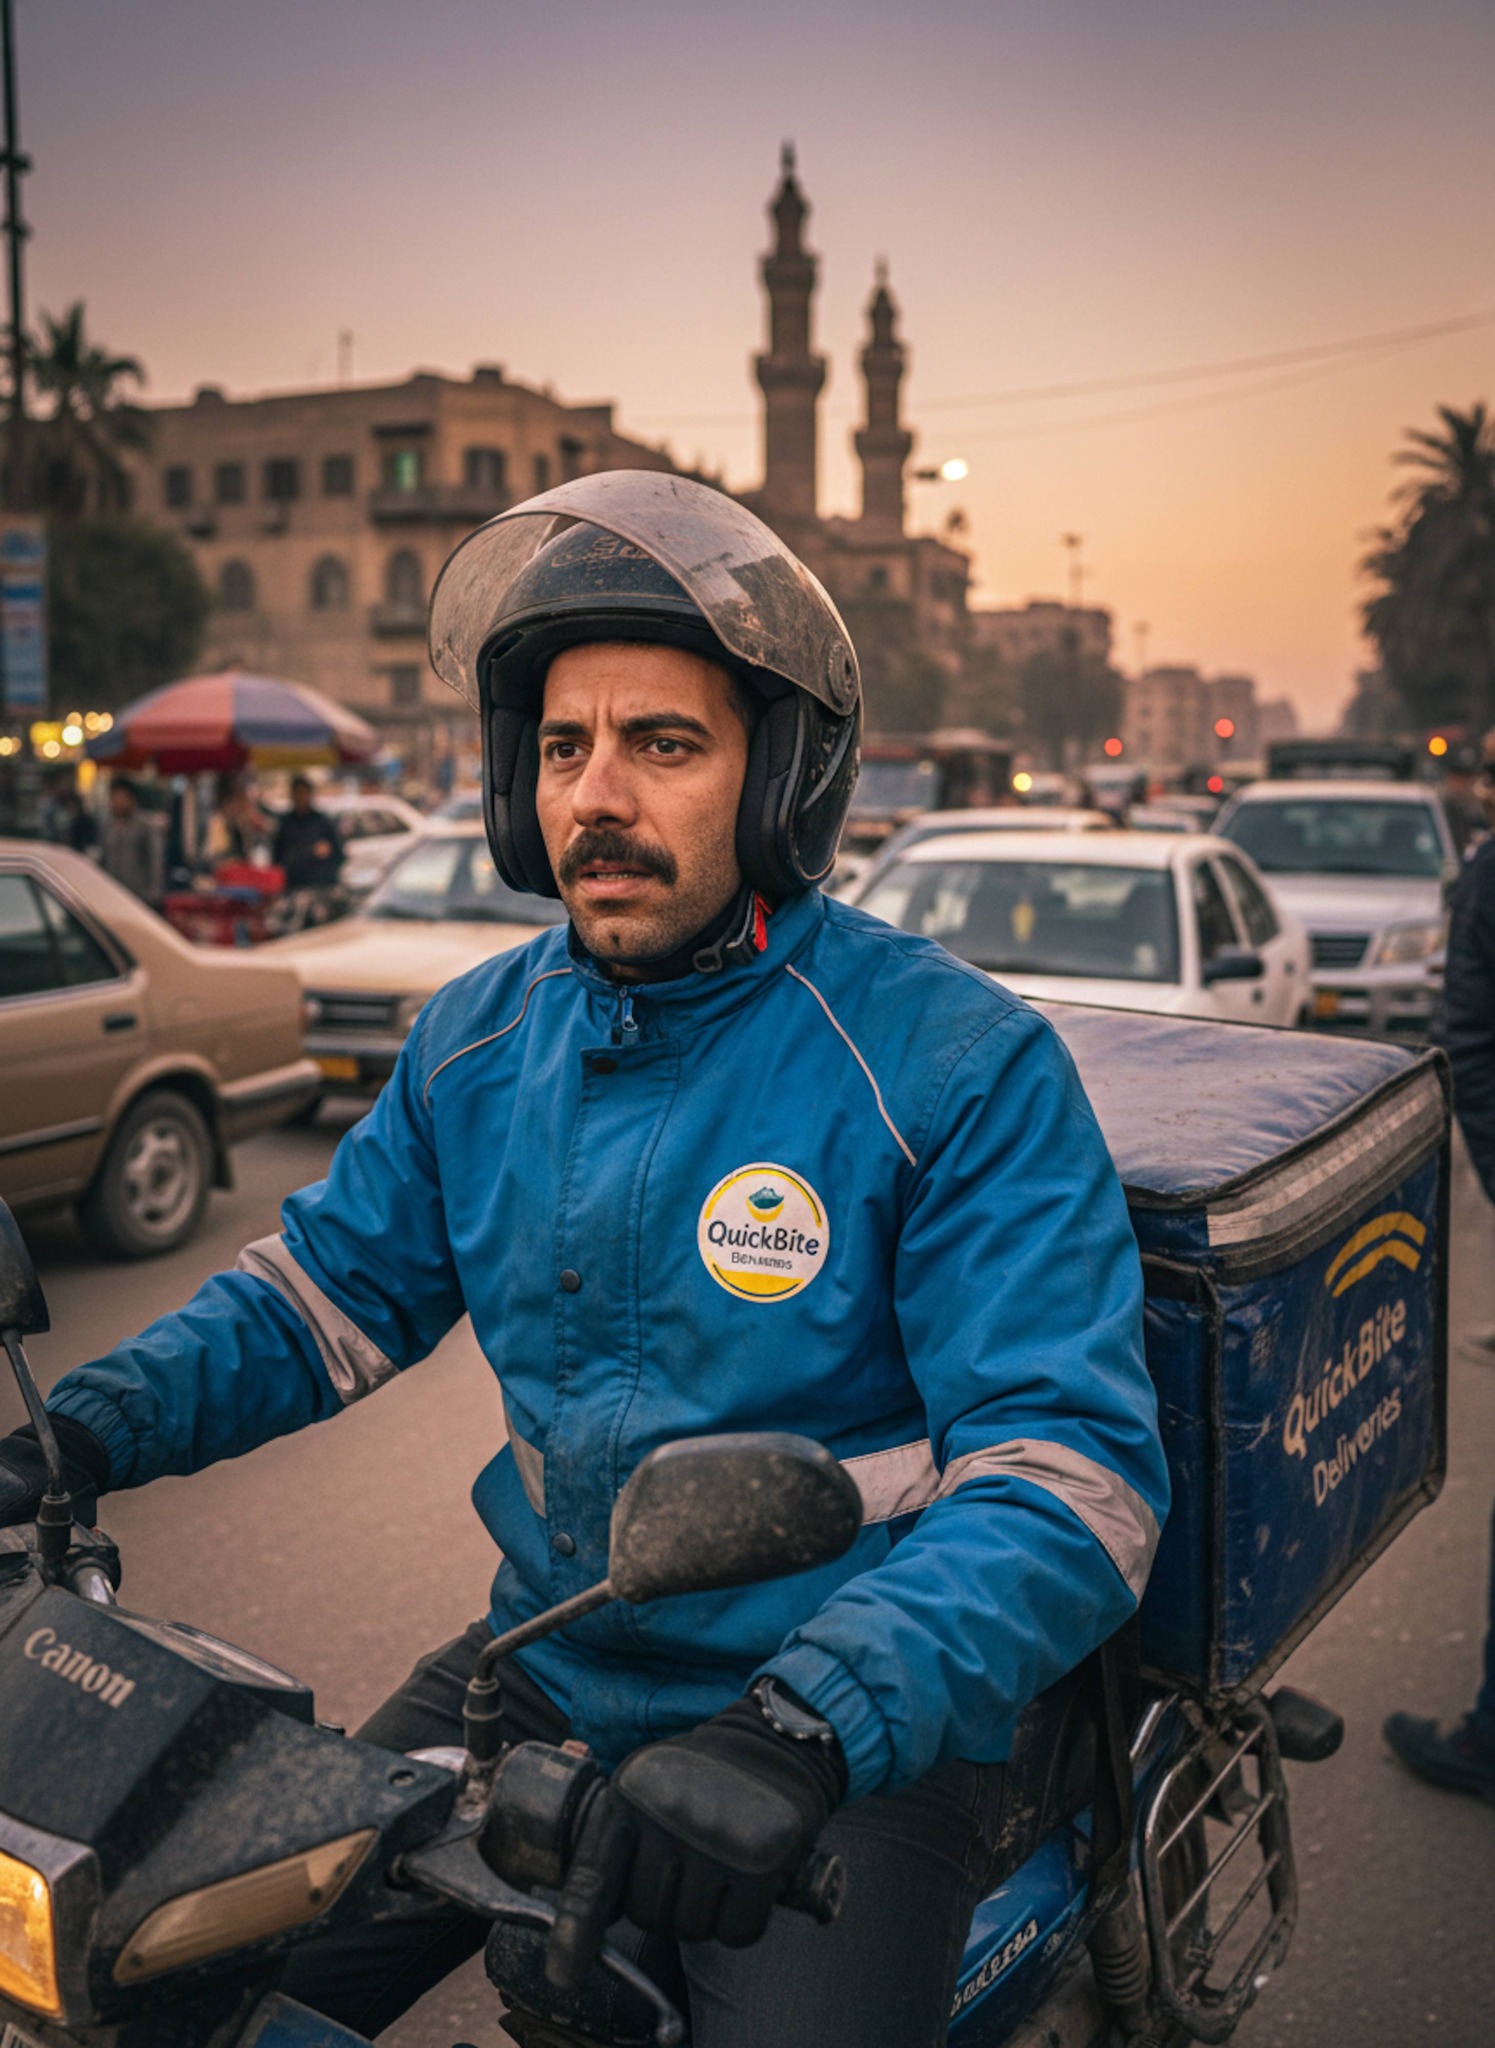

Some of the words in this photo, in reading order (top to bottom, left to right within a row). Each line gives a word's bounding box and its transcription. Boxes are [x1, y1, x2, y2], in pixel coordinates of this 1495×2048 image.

[707, 1220, 820, 1256] QuickBite
[1283, 1298, 1407, 1461] QuickBite
[23, 1627, 137, 1709] Canon
